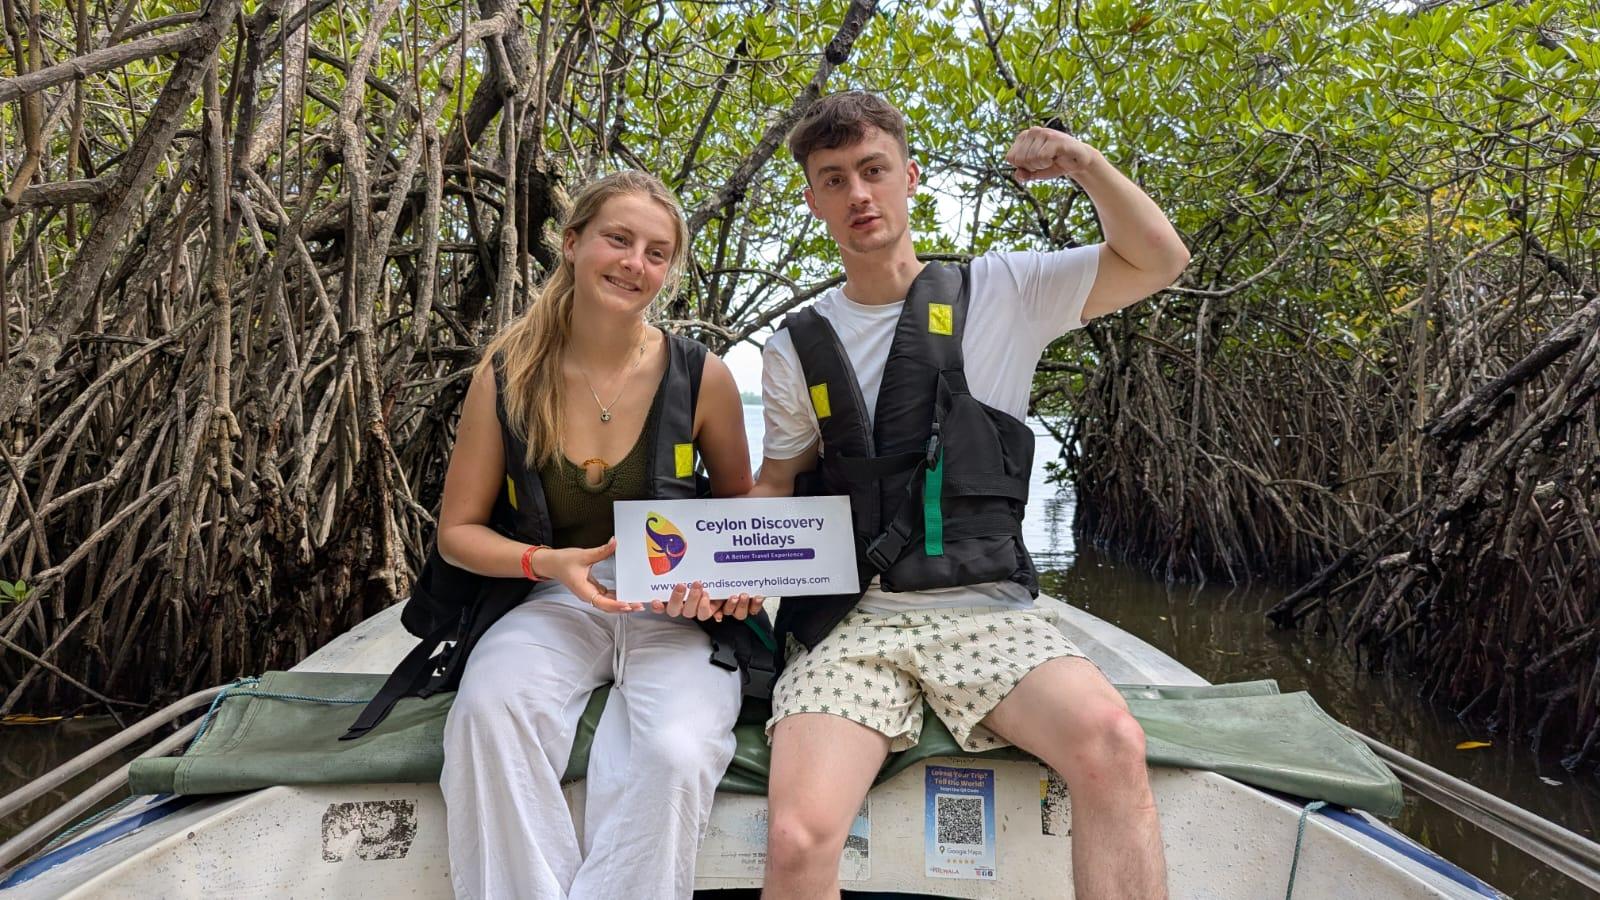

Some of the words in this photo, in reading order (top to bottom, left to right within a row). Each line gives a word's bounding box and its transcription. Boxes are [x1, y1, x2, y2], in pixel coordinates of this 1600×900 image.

[695, 518, 747, 534] Ceylon
[751, 516, 825, 531] Discovery
[732, 533, 796, 548] Holidays
[770, 551, 804, 559] Experience
[952, 770, 969, 778] Your
[935, 777, 946, 785] Tell
[946, 778, 960, 786] the
[947, 847, 967, 856] Google
[967, 848, 982, 857] Maps
